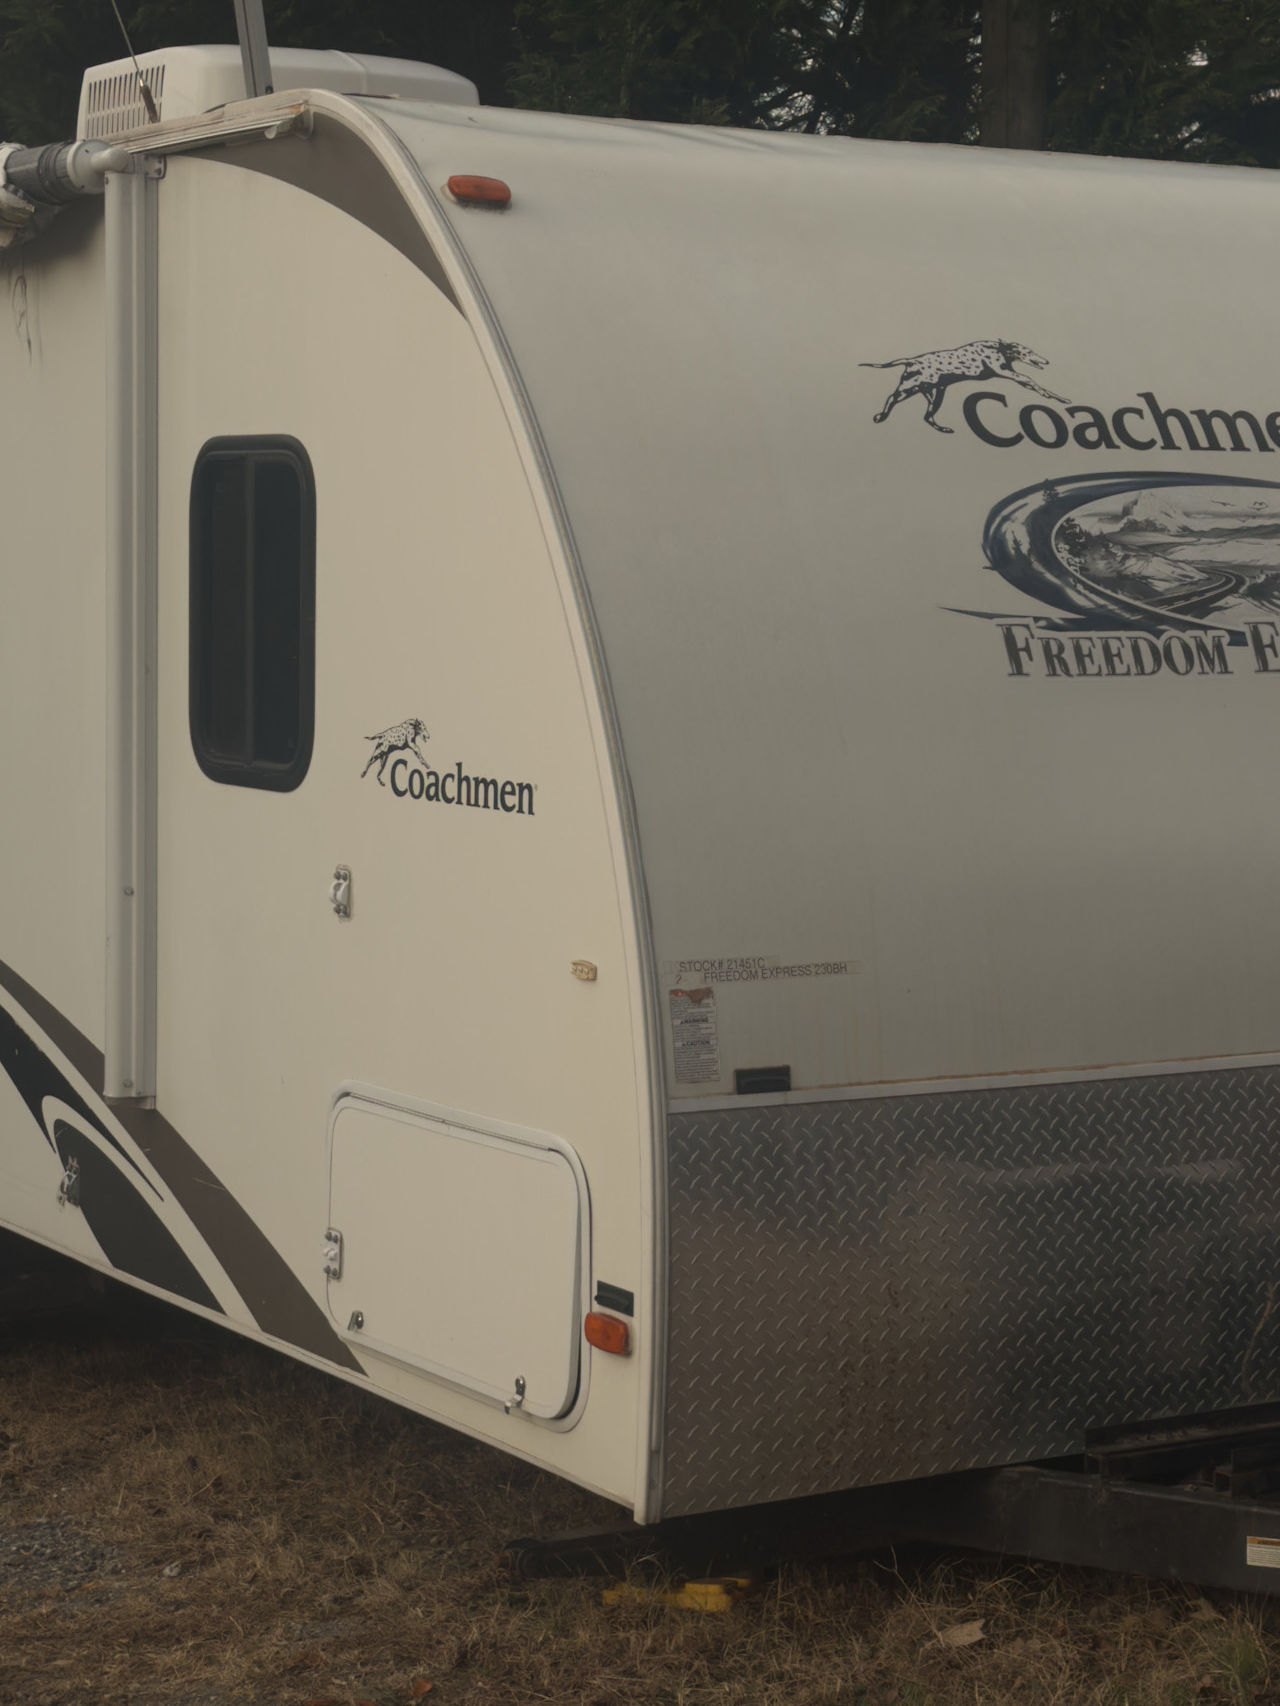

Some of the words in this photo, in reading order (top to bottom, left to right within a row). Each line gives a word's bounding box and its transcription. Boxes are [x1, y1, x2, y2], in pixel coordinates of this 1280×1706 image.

[995, 622, 1235, 677] FREEDOM
[390, 758, 536, 816] Coachmen
[679, 960, 724, 973] STOCK#
[727, 957, 766, 971] 21451C
[704, 969, 759, 983] FREEDOM
[761, 964, 812, 980] EXPRESS
[814, 961, 848, 976] 230BH
